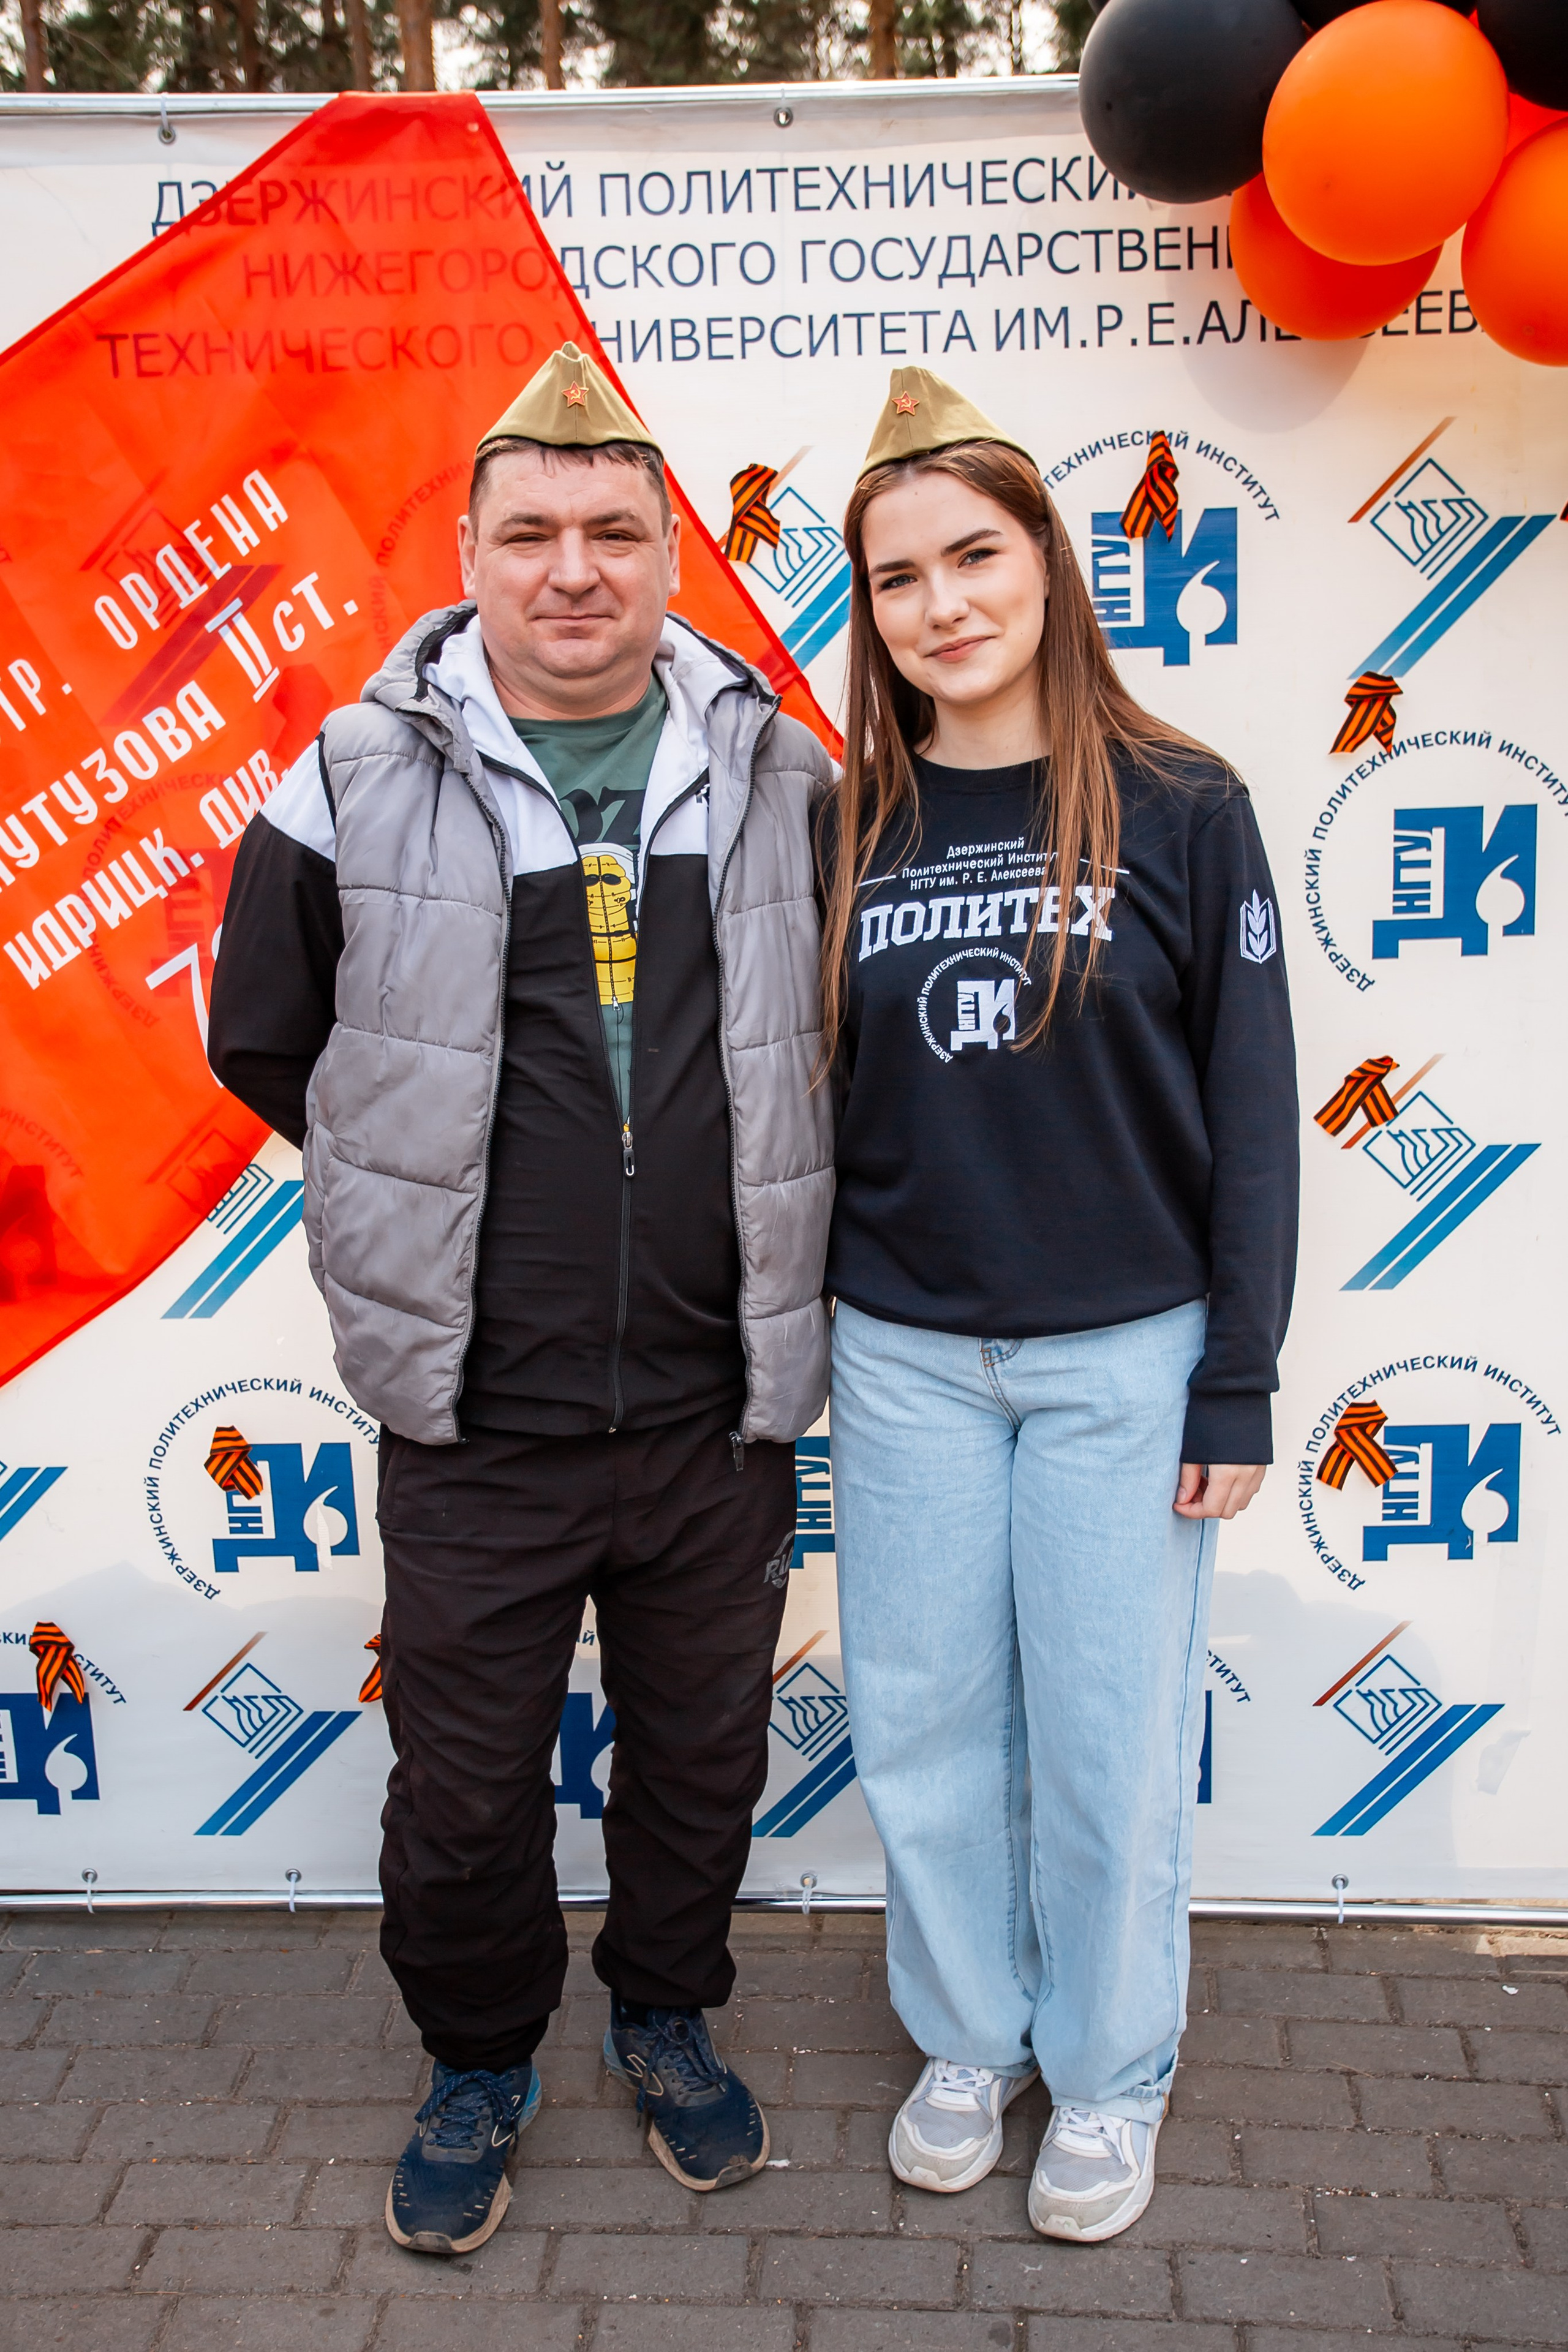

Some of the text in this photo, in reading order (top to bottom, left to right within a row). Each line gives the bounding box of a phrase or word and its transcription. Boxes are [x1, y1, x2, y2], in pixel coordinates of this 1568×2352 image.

[598, 156, 1136, 217] ПОЛИТЕХНИЧЕСКИ
[244, 241, 775, 299] НИЖЕГОРОДСКОГО
[96, 322, 534, 379] ТЕХНИЧЕСКОГО
[1196, 440, 1280, 522] ИНСТИТУТ
[94, 469, 288, 650] ОРДЕНА
[273, 571, 359, 652] СТ.
[902, 854, 1003, 879] Политехнический
[910, 876, 937, 891] НГТУ
[939, 876, 959, 887] им.
[962, 872, 973, 884] Р.
[977, 871, 987, 883] Е.
[947, 837, 1025, 859] Дзержинский
[1304, 730, 1568, 992] ДЗЕРЖИНСКИЙ ПОЛИТЕХНИЧЕСКИЙ ИНСТИТУ
[3, 827, 205, 990] ИДРИЦК.
[859, 885, 1116, 963] ПОЛИТЕХ
[921, 947, 1000, 996] ПОЛИТЕХНИЧЕСКИЙ
[917, 997, 954, 1063] ДЗЕРЖИНСКИЙ
[143, 1378, 380, 1600] ДЗЕРЖИНСКИЙ ПОЛИТЕХНИЧЕСКИЙ ИНСТИТУ
[1297, 1355, 1562, 1591] ДЗЕРЖИНСКИЙ ПОЛИТЕХНИЧЕСКИЙ ИНСТИТУТ
